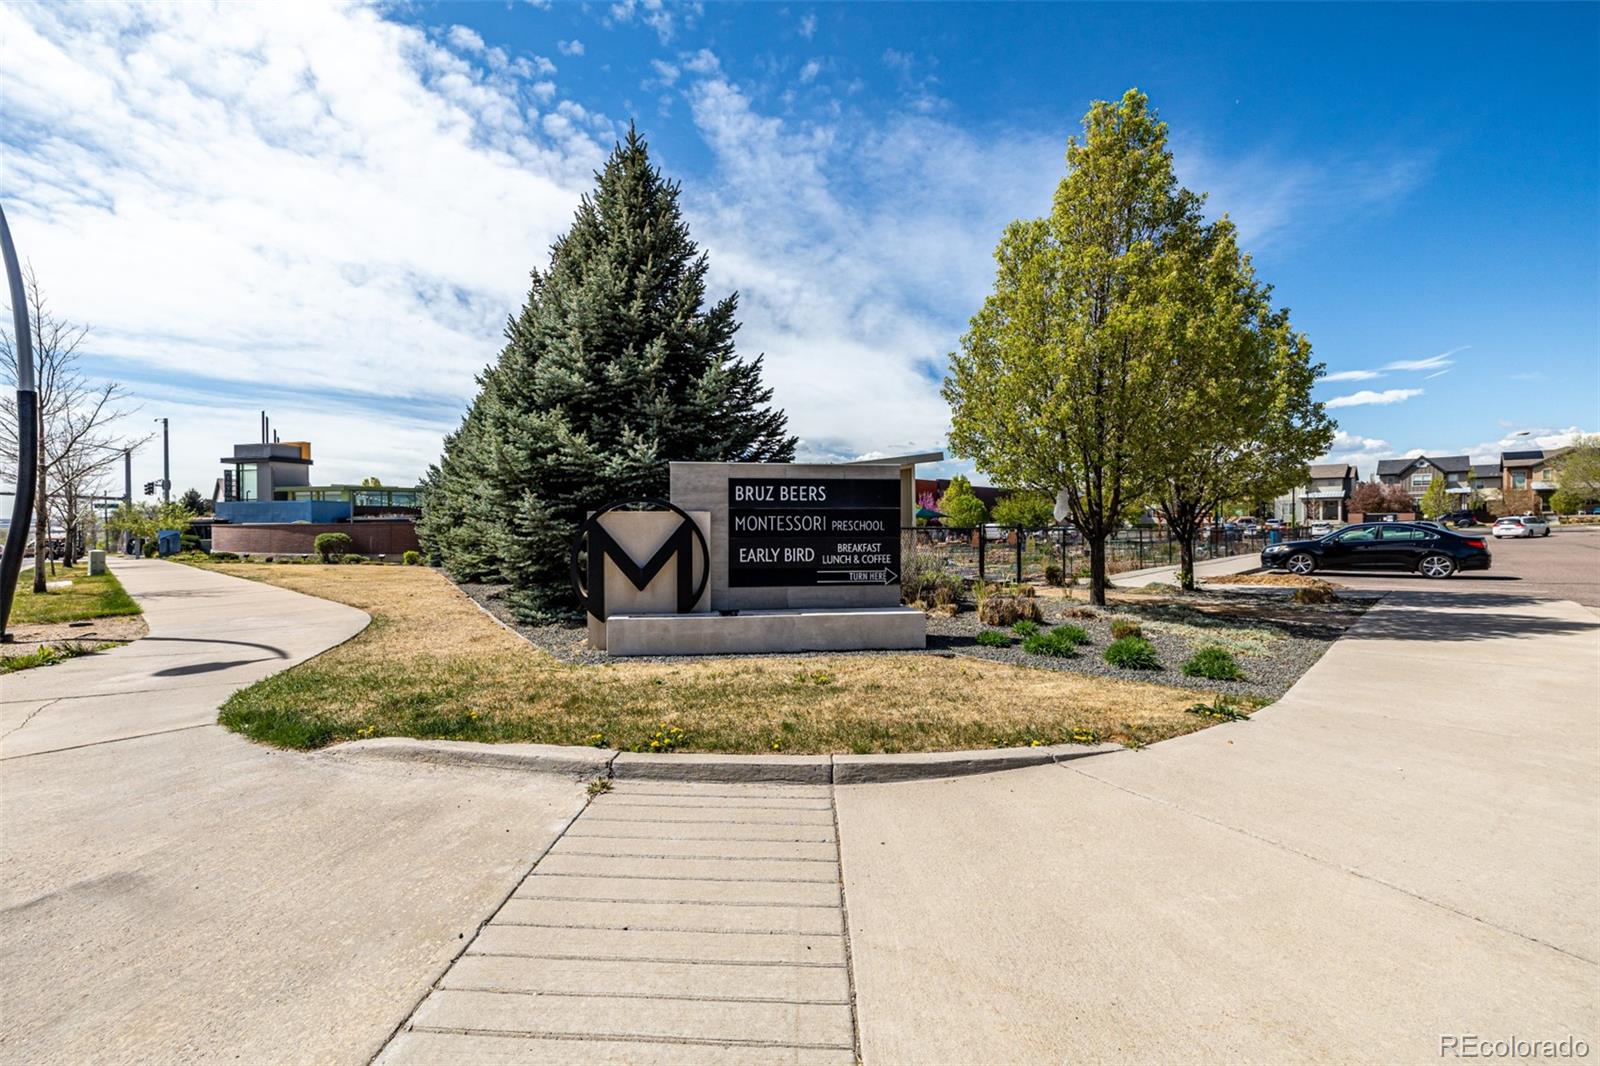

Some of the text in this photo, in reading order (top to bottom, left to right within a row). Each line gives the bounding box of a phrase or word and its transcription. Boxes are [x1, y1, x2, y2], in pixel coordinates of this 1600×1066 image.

[735, 486, 826, 501] BRUZ BEERS
[735, 515, 885, 531] MONTESSORI PRESCHOOL
[837, 543, 882, 552] BREAKFAST
[739, 548, 815, 562] EARLY BIRD
[822, 554, 891, 564] LUNCH & COFFEE
[588, 508, 693, 623] M
[849, 572, 887, 580] TURN HERE
